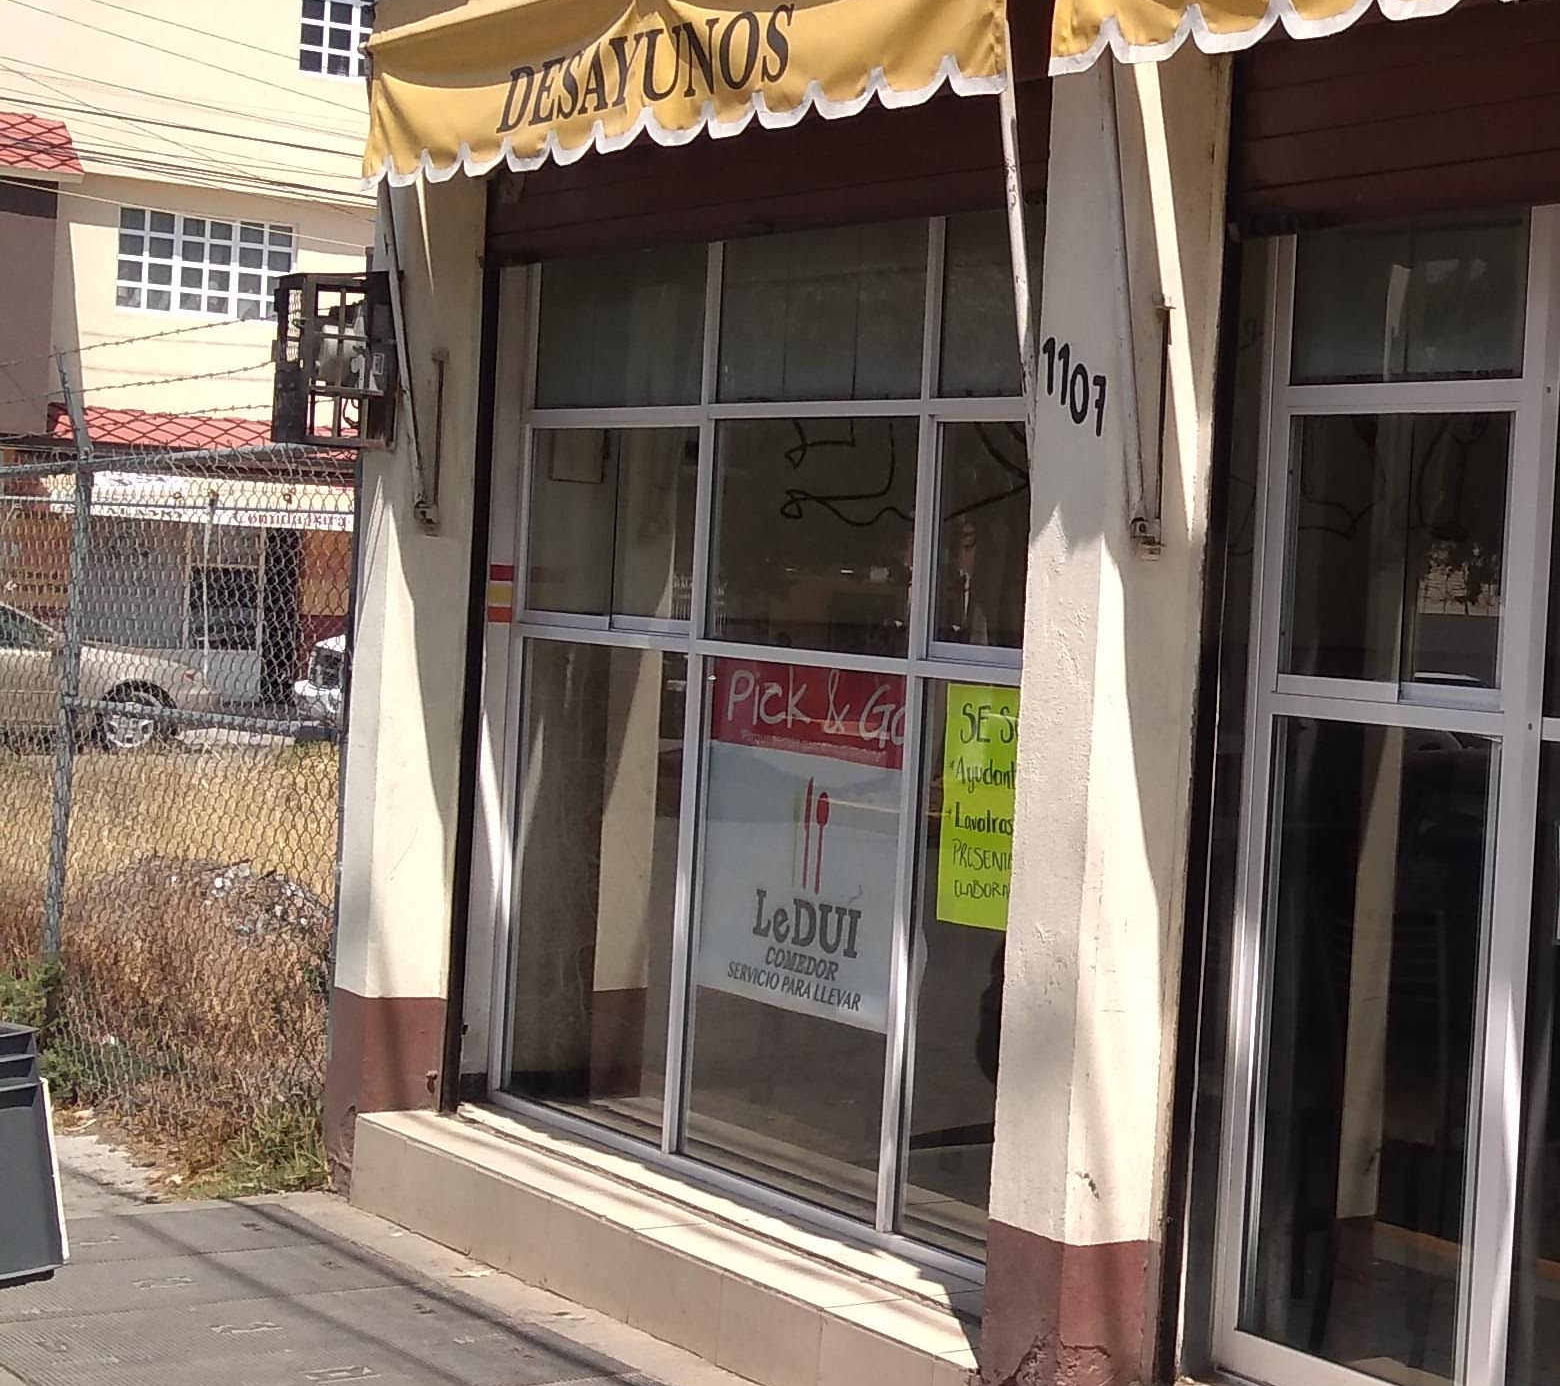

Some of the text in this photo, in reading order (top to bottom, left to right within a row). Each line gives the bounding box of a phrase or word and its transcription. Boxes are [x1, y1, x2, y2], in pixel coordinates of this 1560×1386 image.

[495, 3, 795, 134] DESAYUNOS
[1042, 336, 1107, 437] 1107
[727, 666, 812, 730] Pick
[823, 669, 851, 734] &
[960, 702, 992, 745] SE
[752, 888, 862, 959] LeDUI
[728, 960, 862, 1012] SERVICIO PARA LLEVAR
[765, 946, 839, 982] COMEDOR
